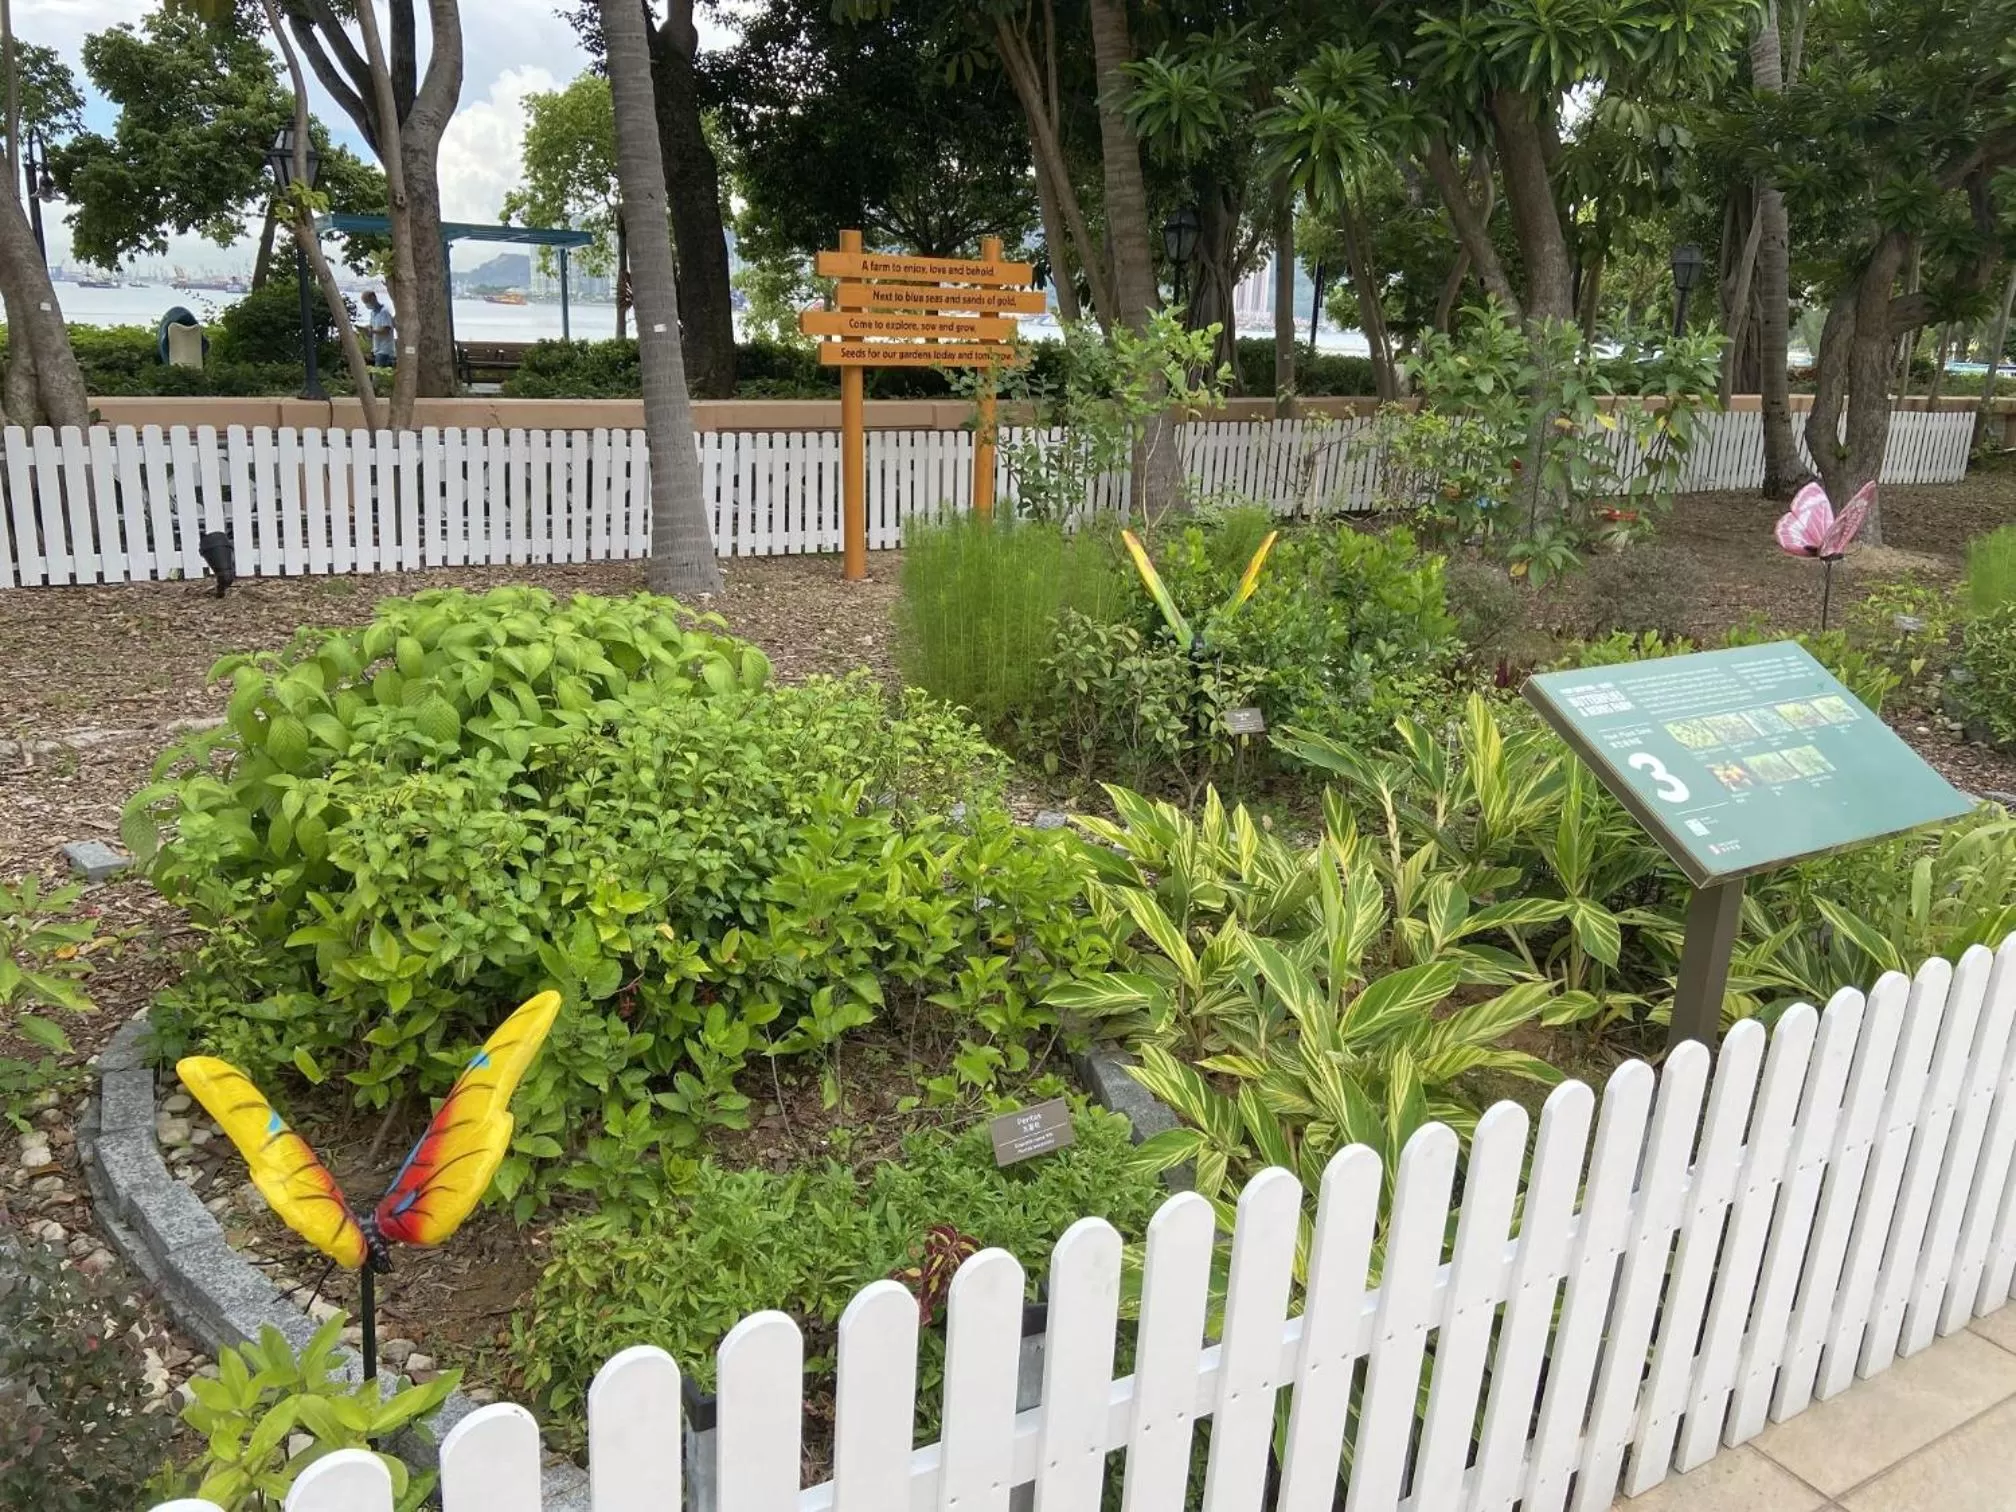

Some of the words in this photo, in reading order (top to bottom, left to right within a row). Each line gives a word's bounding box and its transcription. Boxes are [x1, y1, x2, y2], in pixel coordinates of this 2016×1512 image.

[862, 260, 869, 271] A
[871, 261, 890, 271] farm
[892, 262, 901, 272] to
[929, 264, 946, 275] love
[948, 265, 964, 275] and
[873, 290, 892, 301] Next
[894, 291, 904, 301] to
[905, 292, 924, 302] blue
[925, 293, 943, 304] seas
[945, 294, 960, 304] and
[962, 294, 985, 305] sands
[986, 295, 996, 305] of
[849, 318, 873, 329] Come
[874, 319, 884, 329] to
[920, 322, 937, 332] sow
[938, 322, 954, 332] and
[840, 347, 866, 359] Seeds
[868, 348, 881, 359] for
[882, 349, 897, 360] our
[898, 350, 932, 361] gardens
[933, 350, 955, 362] today
[957, 350, 973, 361] and
[974, 351, 1013, 362] tomow.
[1628, 752, 1690, 803] 3
